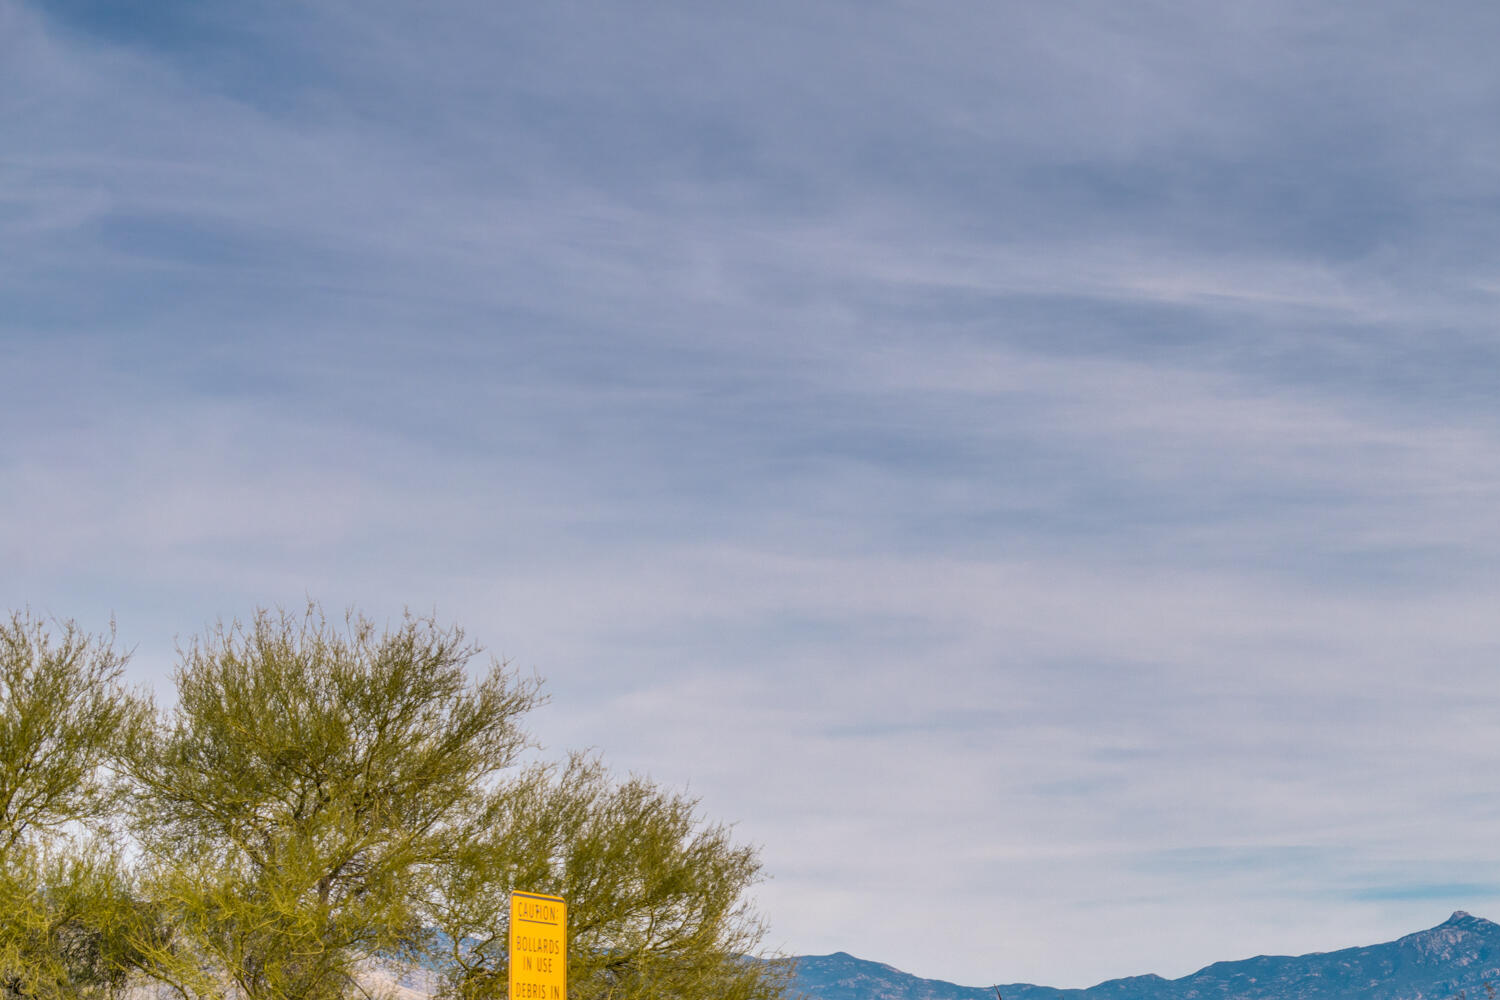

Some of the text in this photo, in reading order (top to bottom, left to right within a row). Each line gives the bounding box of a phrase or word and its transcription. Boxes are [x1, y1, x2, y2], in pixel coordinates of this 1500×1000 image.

[516, 936, 560, 955] BOLLARDS
[523, 956, 552, 973] IN USE
[516, 982, 560, 1000] DEBRIS IN
